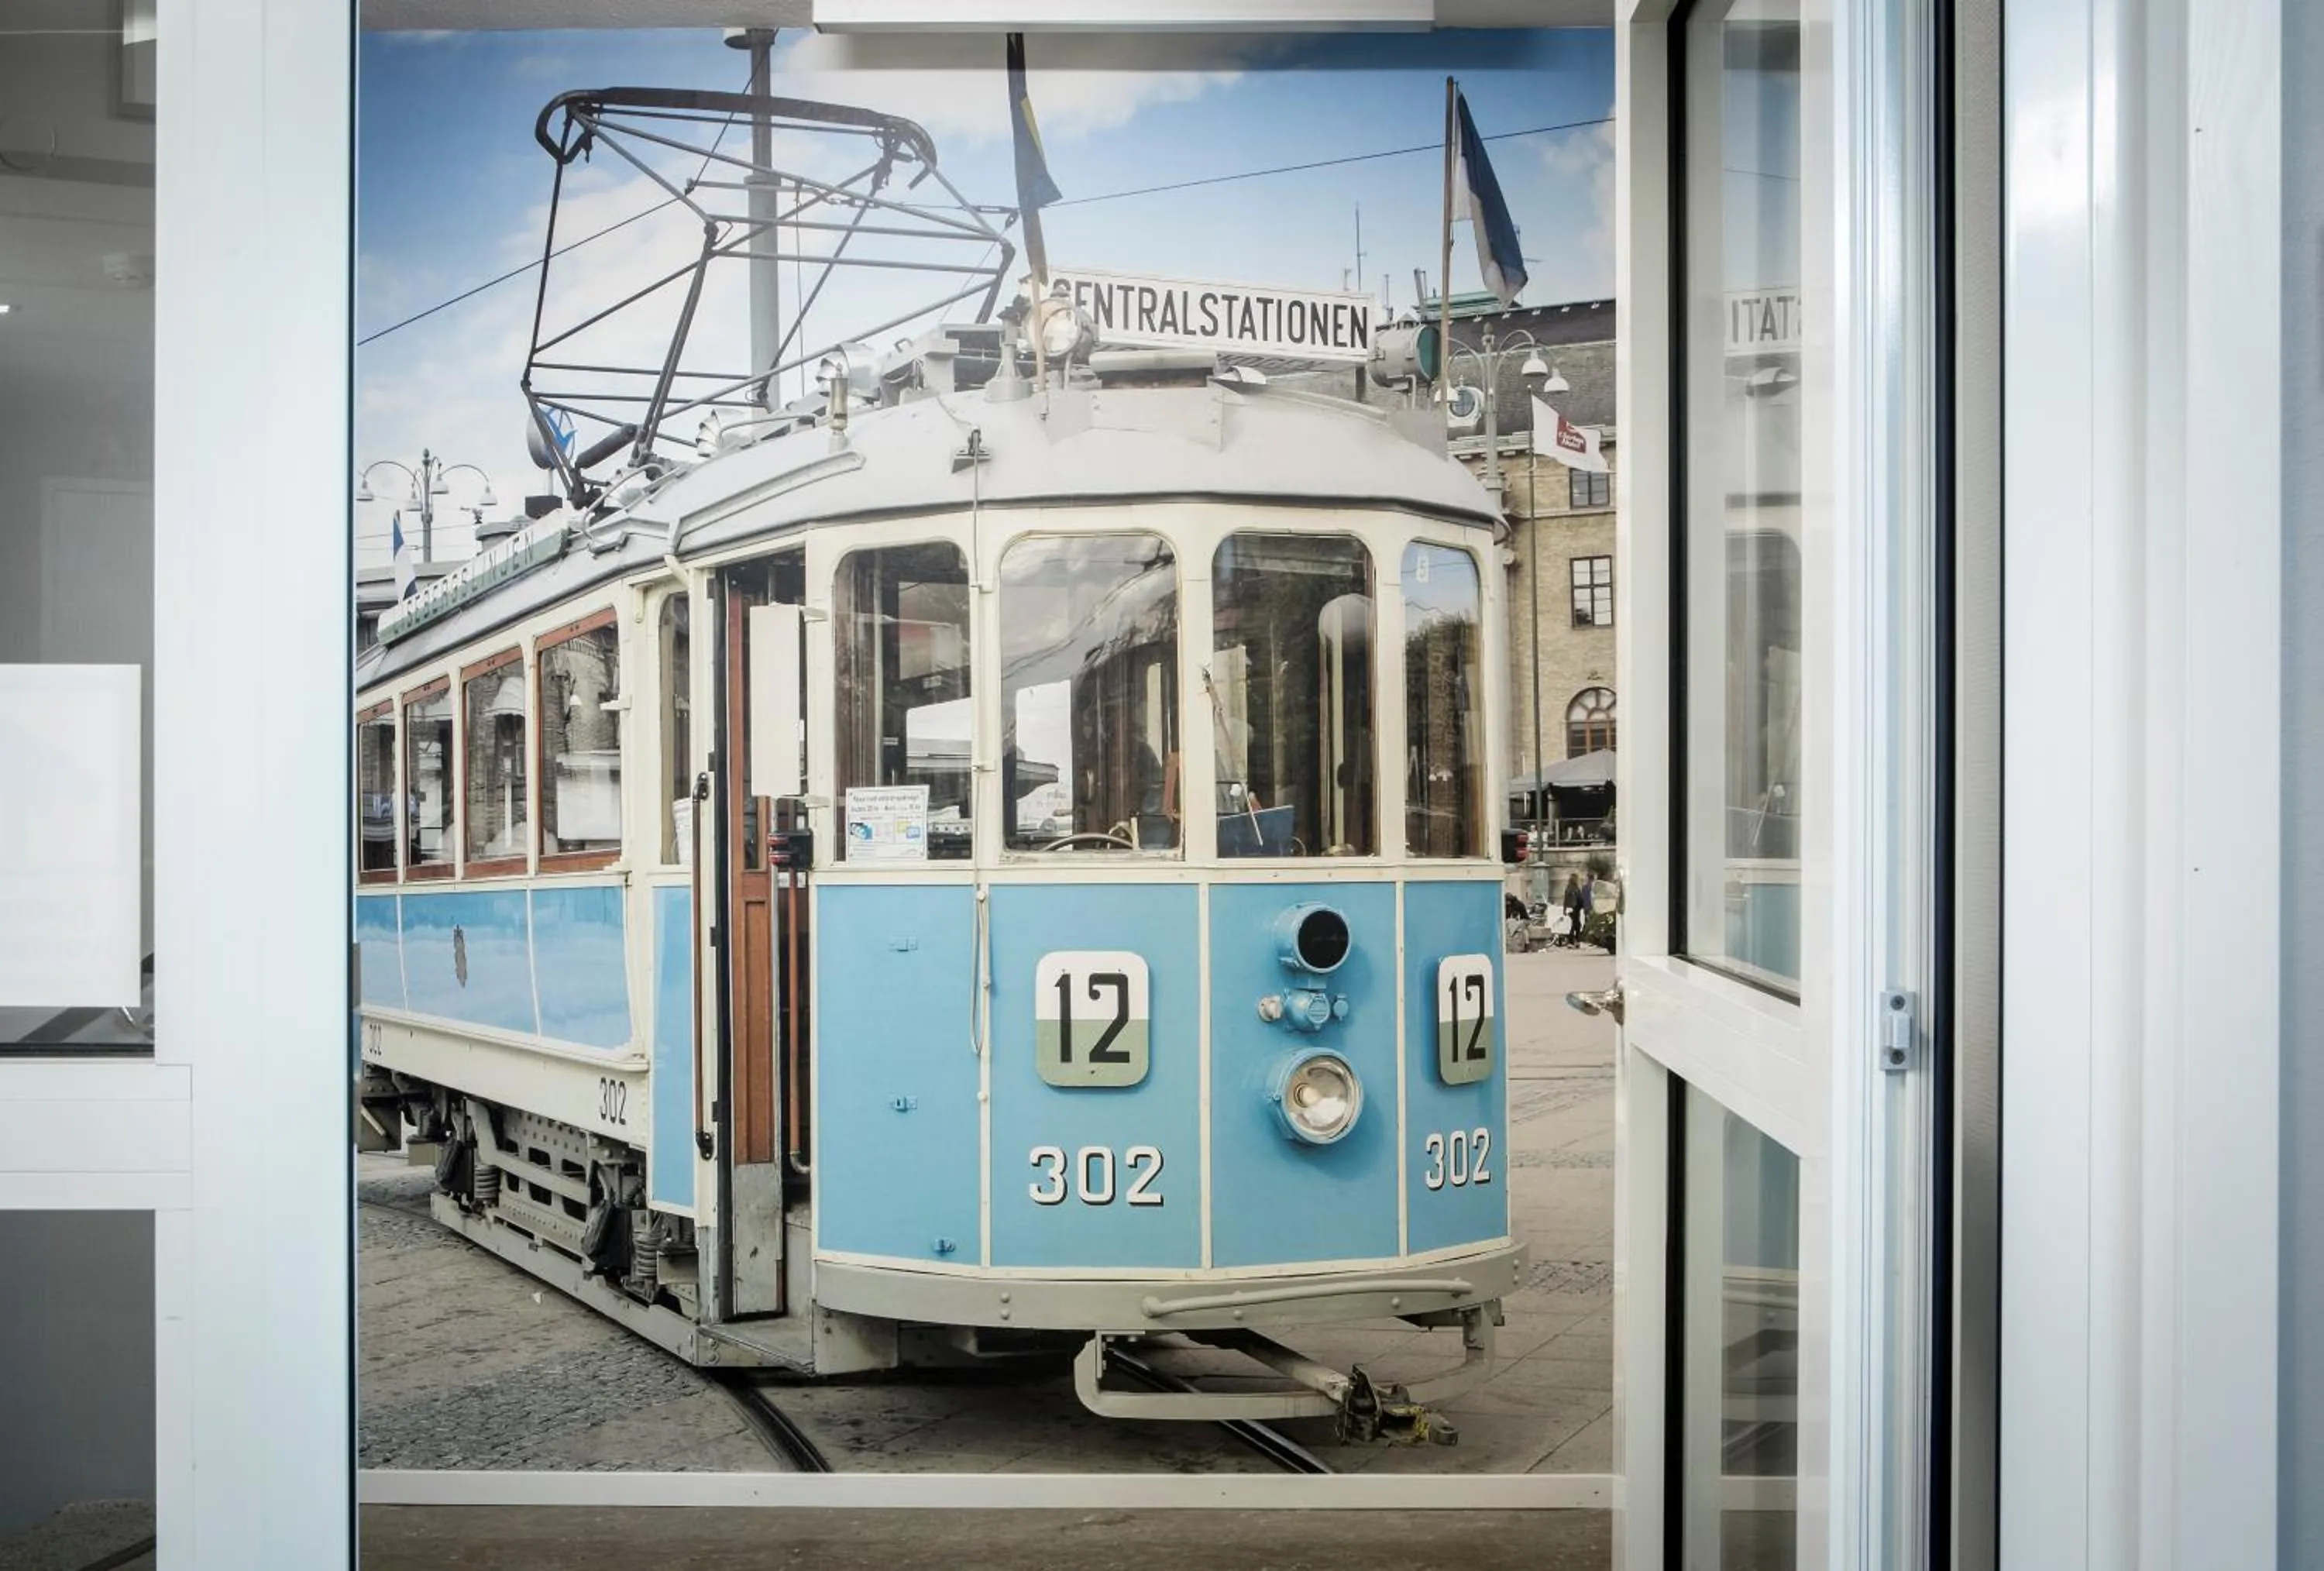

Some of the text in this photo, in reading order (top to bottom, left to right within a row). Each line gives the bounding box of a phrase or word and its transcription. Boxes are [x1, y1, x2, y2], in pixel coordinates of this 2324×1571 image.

[1053, 278, 1368, 349] ENTRALSTATIONEN
[1054, 973, 1130, 1064] 12
[1448, 974, 1487, 1064] 12
[599, 1077, 627, 1126] 302
[1028, 1146, 1164, 1205] 302
[1425, 1127, 1492, 1191] 302
